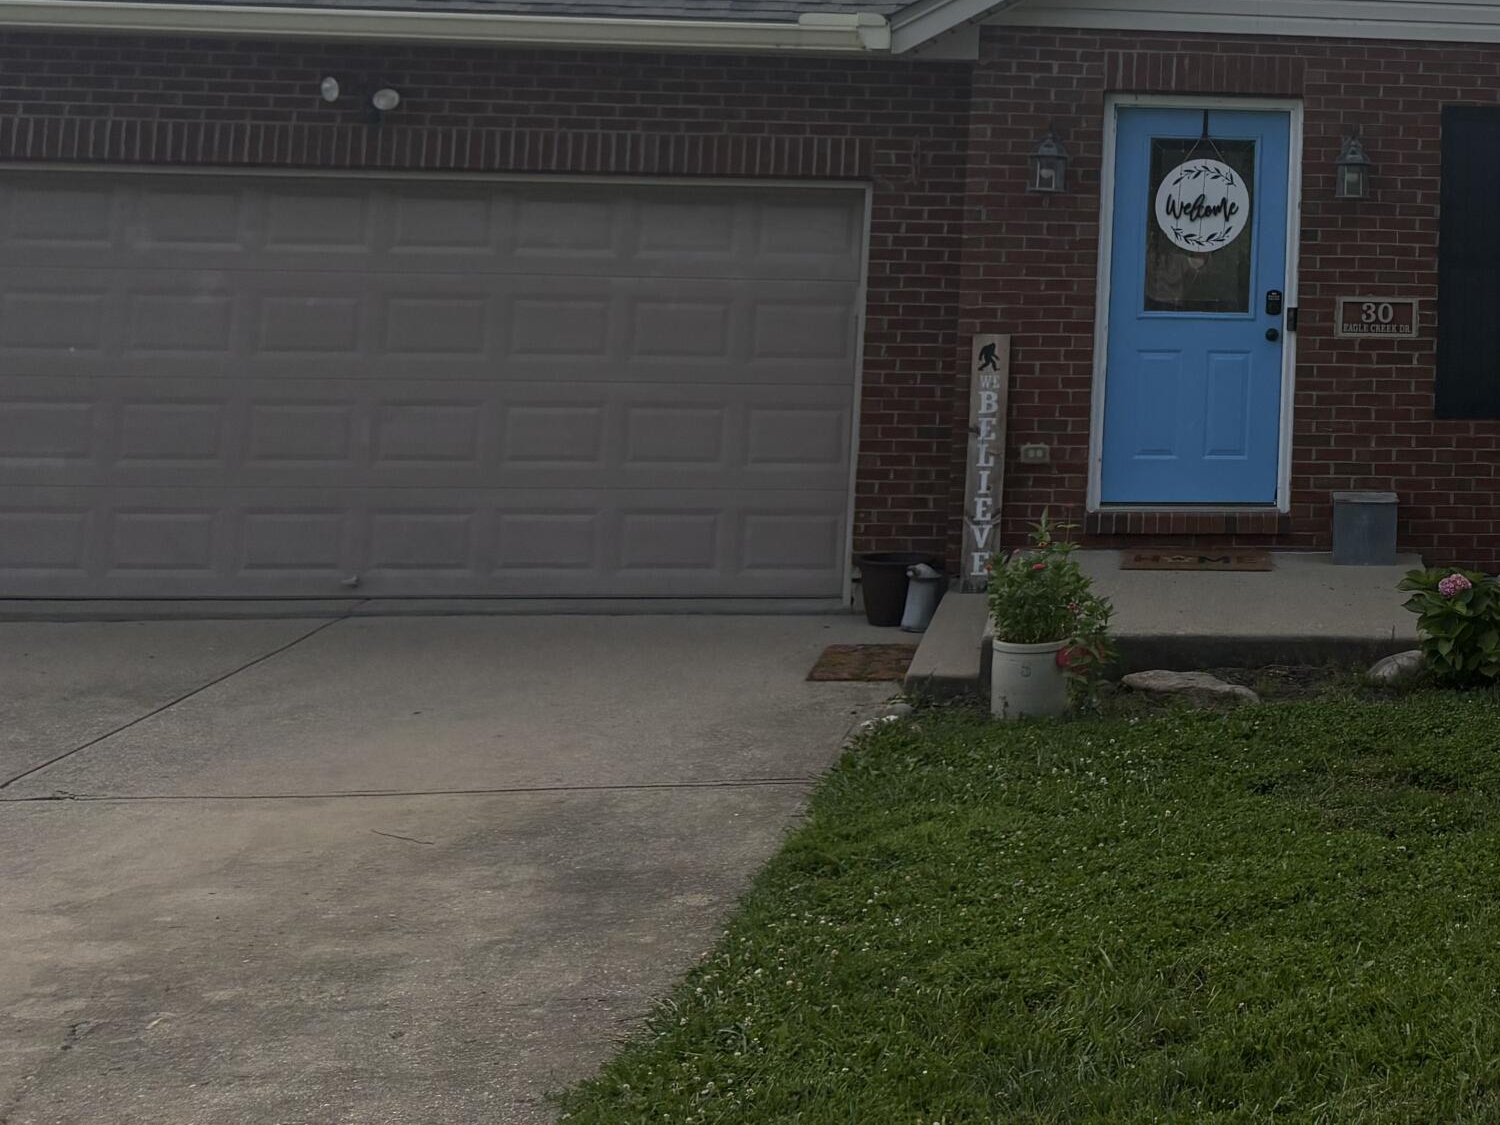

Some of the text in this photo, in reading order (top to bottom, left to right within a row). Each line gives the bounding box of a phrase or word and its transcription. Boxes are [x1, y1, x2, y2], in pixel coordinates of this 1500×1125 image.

[1166, 194, 1239, 223] Welcome
[1361, 302, 1394, 324] 30
[1343, 323, 1369, 332] EAGLE
[1370, 323, 1398, 333] CREEK
[980, 375, 1001, 389] WE
[970, 390, 999, 576] BELIEVE
